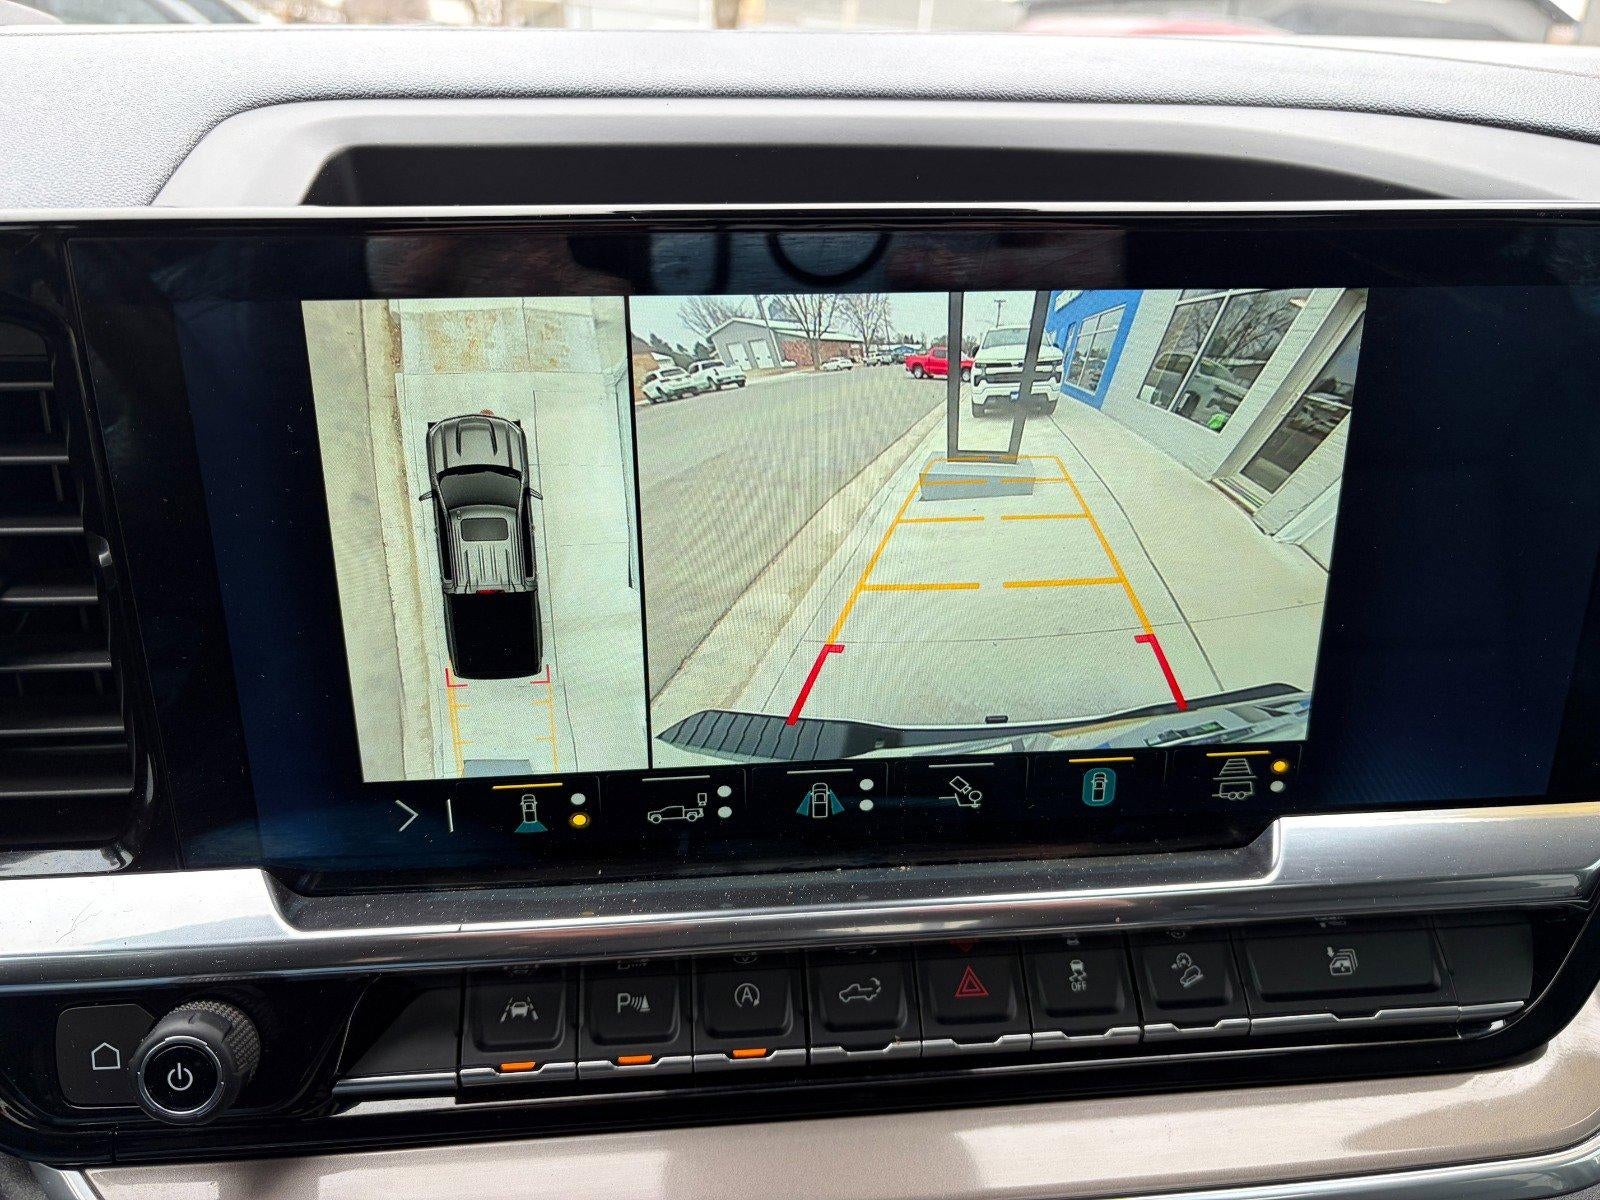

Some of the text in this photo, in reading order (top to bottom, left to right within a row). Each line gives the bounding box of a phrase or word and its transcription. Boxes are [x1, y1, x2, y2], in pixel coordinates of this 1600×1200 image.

[741, 986, 754, 1003] A
[1071, 981, 1087, 992] OFF
[617, 992, 631, 1013] P
